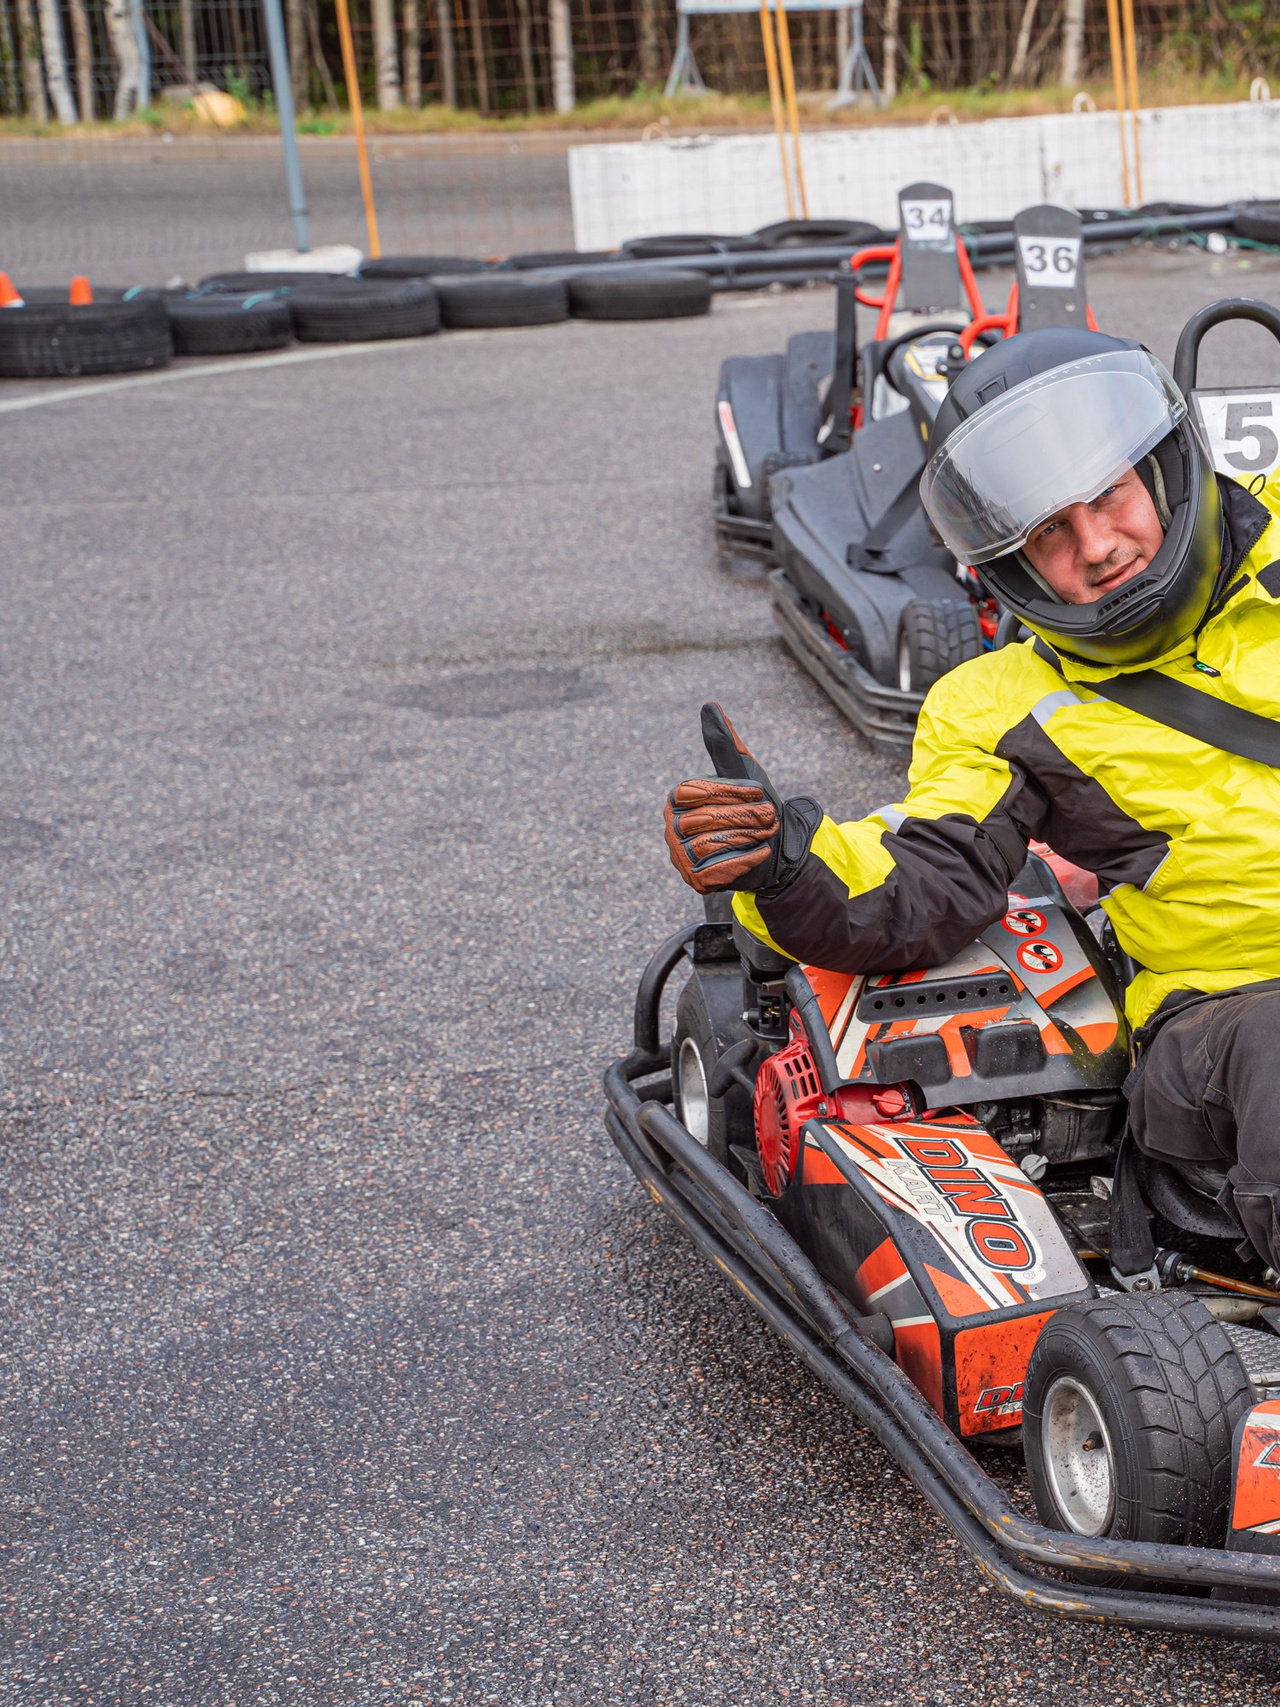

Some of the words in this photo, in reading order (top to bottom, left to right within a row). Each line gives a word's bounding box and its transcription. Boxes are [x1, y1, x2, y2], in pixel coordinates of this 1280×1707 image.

[908, 207, 950, 229] 34
[1026, 245, 1076, 273] 36
[1223, 401, 1279, 472] 5
[886, 1160, 952, 1223] KART
[893, 1137, 1037, 1272] DINO
[975, 1382, 1025, 1412] DI
